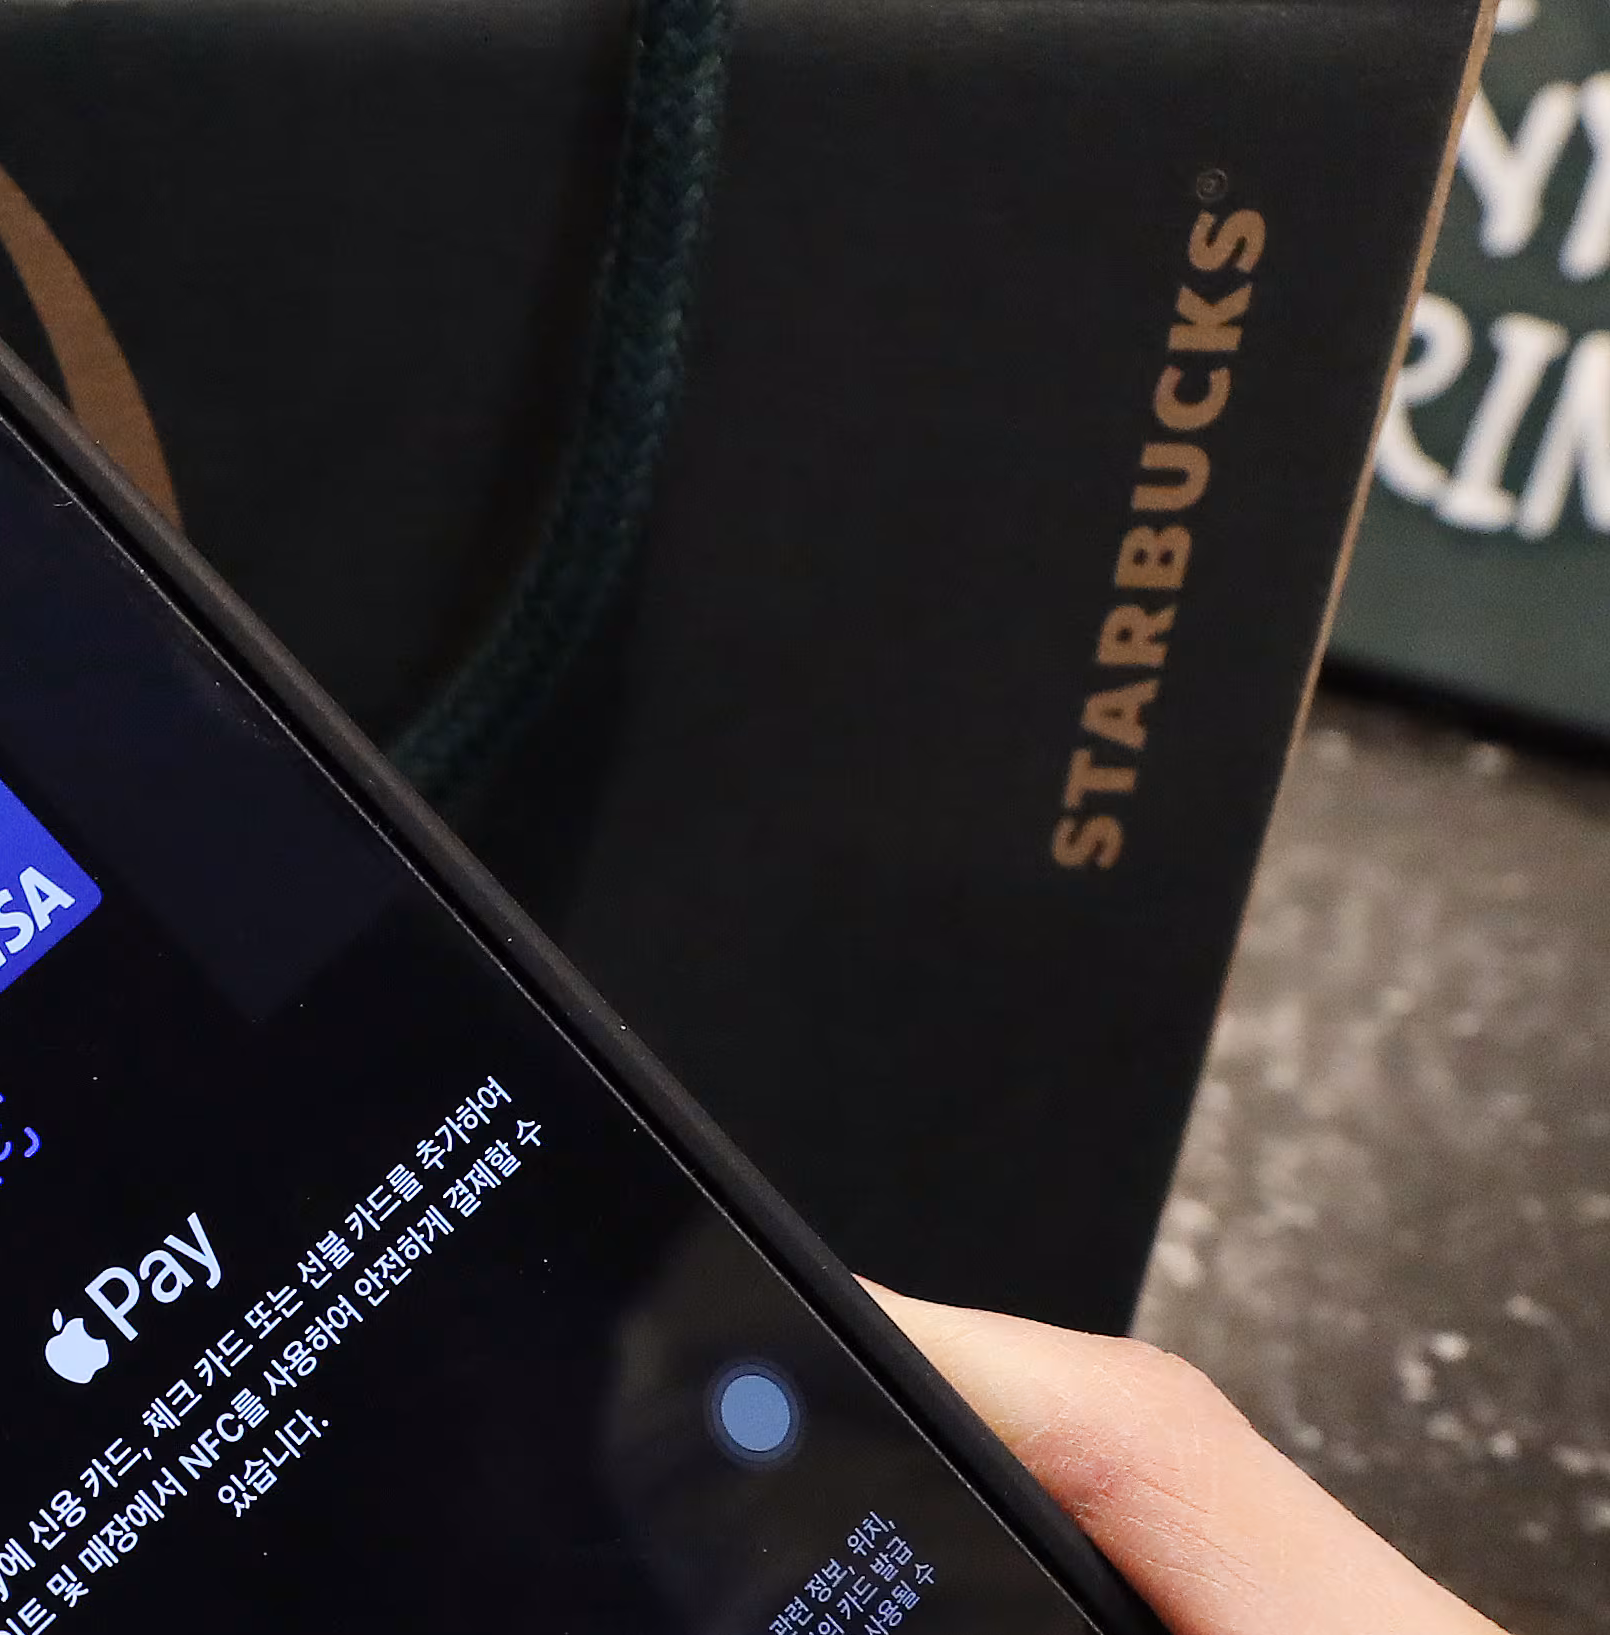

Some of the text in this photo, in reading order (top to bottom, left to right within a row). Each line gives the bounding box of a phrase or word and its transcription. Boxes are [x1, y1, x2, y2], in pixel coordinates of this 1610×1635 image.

[1052, 207, 1266, 871] STARBUCKS
[28, 1489, 87, 1551] 신용
[79, 1437, 153, 1498] 카드,
[141, 1378, 203, 1438] 체크
[193, 1329, 254, 1387] 카드
[243, 1285, 304, 1340] 또는
[296, 1230, 355, 1290] 선불
[344, 1163, 424, 1241] 카드를
[415, 1075, 512, 1170] 추가하여
[86, 1212, 227, 1338] Pay
[45, 1564, 90, 1608] 및
[77, 1466, 188, 1574] 매장에서
[178, 1387, 270, 1480] NFC를
[262, 1294, 364, 1397] 사용하여
[354, 1204, 455, 1307] 안전하게
[442, 1139, 522, 1218] 결제할
[516, 1119, 542, 1147] 수
[217, 1409, 329, 1518] 있습니다.
[803, 1558, 856, 1603] 정보,
[836, 1575, 879, 1620] 카드
[914, 1563, 935, 1585] 수
